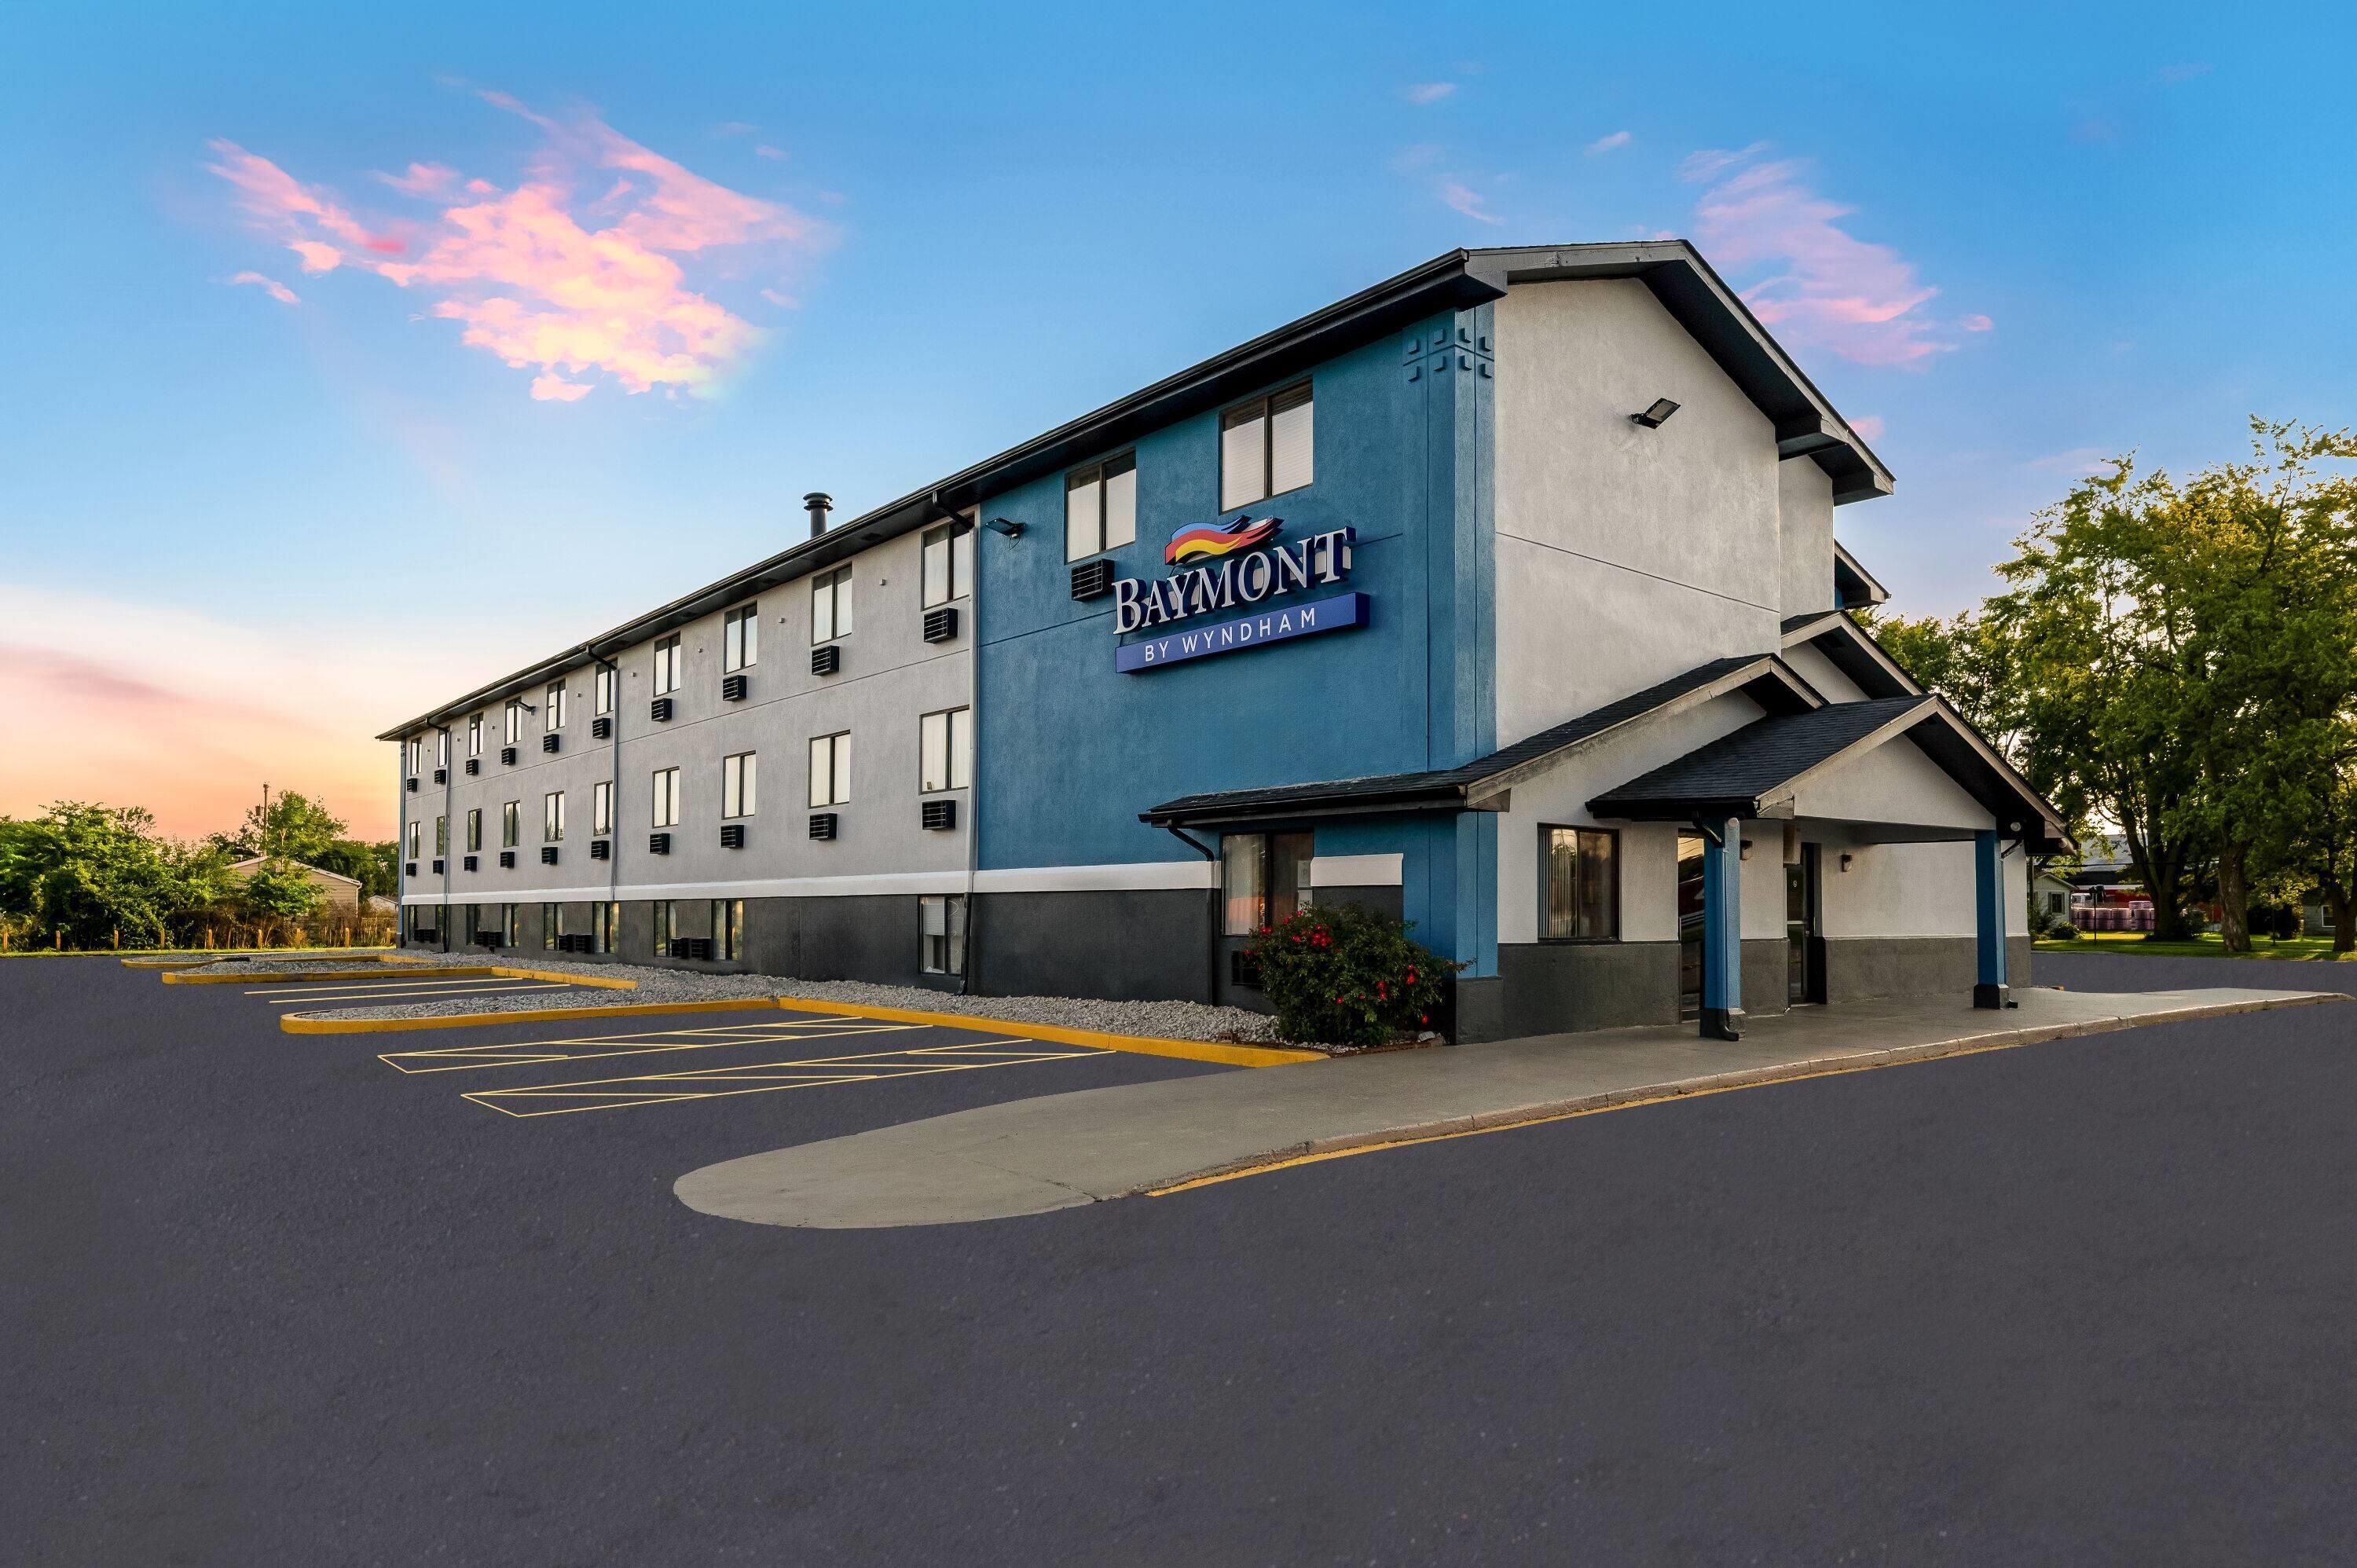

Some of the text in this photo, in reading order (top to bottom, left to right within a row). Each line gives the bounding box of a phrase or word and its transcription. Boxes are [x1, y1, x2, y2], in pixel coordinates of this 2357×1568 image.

[1112, 526, 1353, 635] BAYMONT
[1145, 607, 1316, 662] BY WYNDHAM
